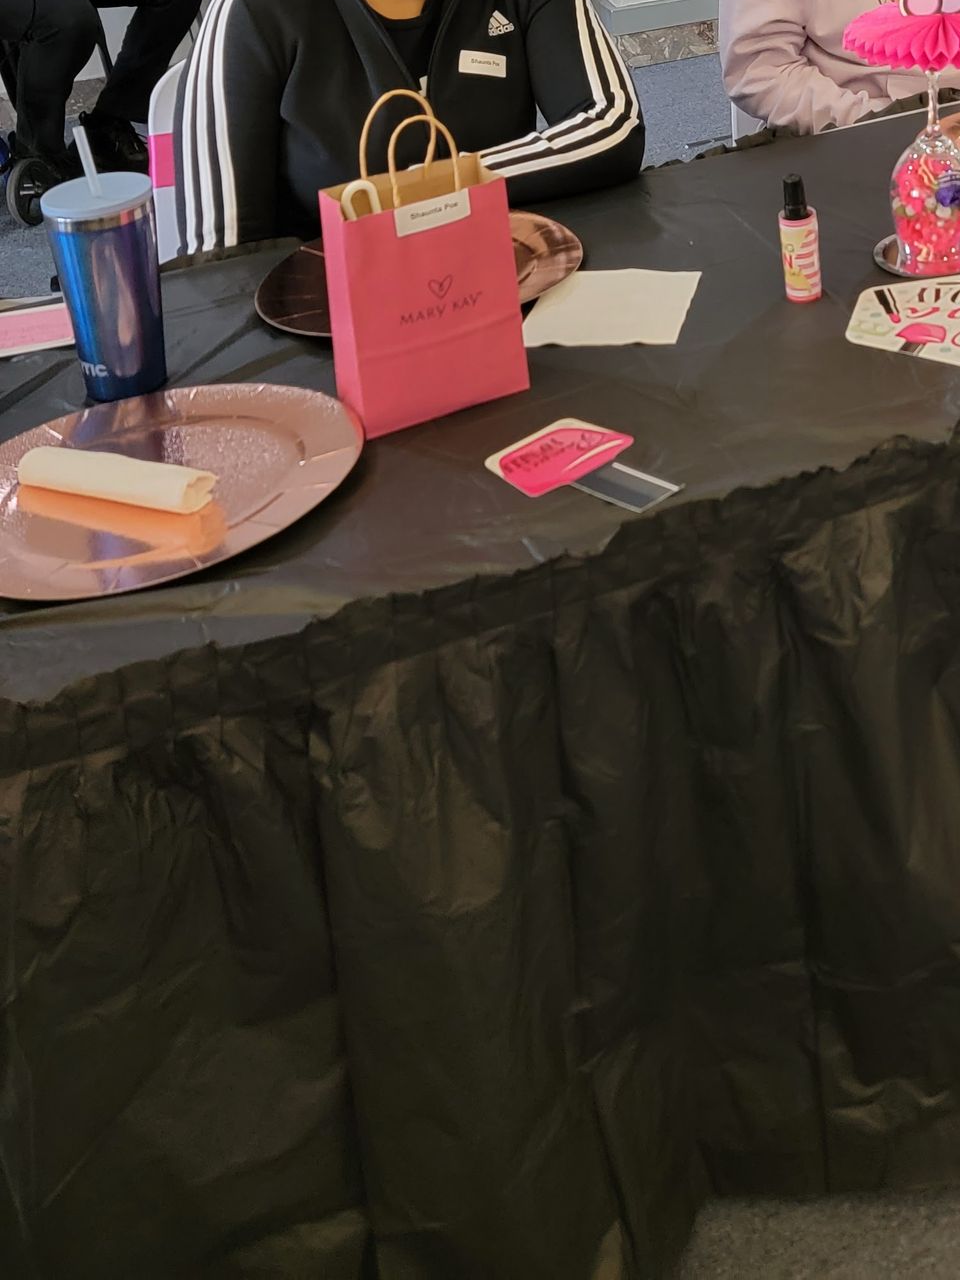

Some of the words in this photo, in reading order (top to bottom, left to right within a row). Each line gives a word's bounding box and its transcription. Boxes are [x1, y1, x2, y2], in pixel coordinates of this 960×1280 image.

[488, 22, 514, 36] adidas
[400, 303, 446, 326] MARY
[452, 291, 482, 312] KAY
